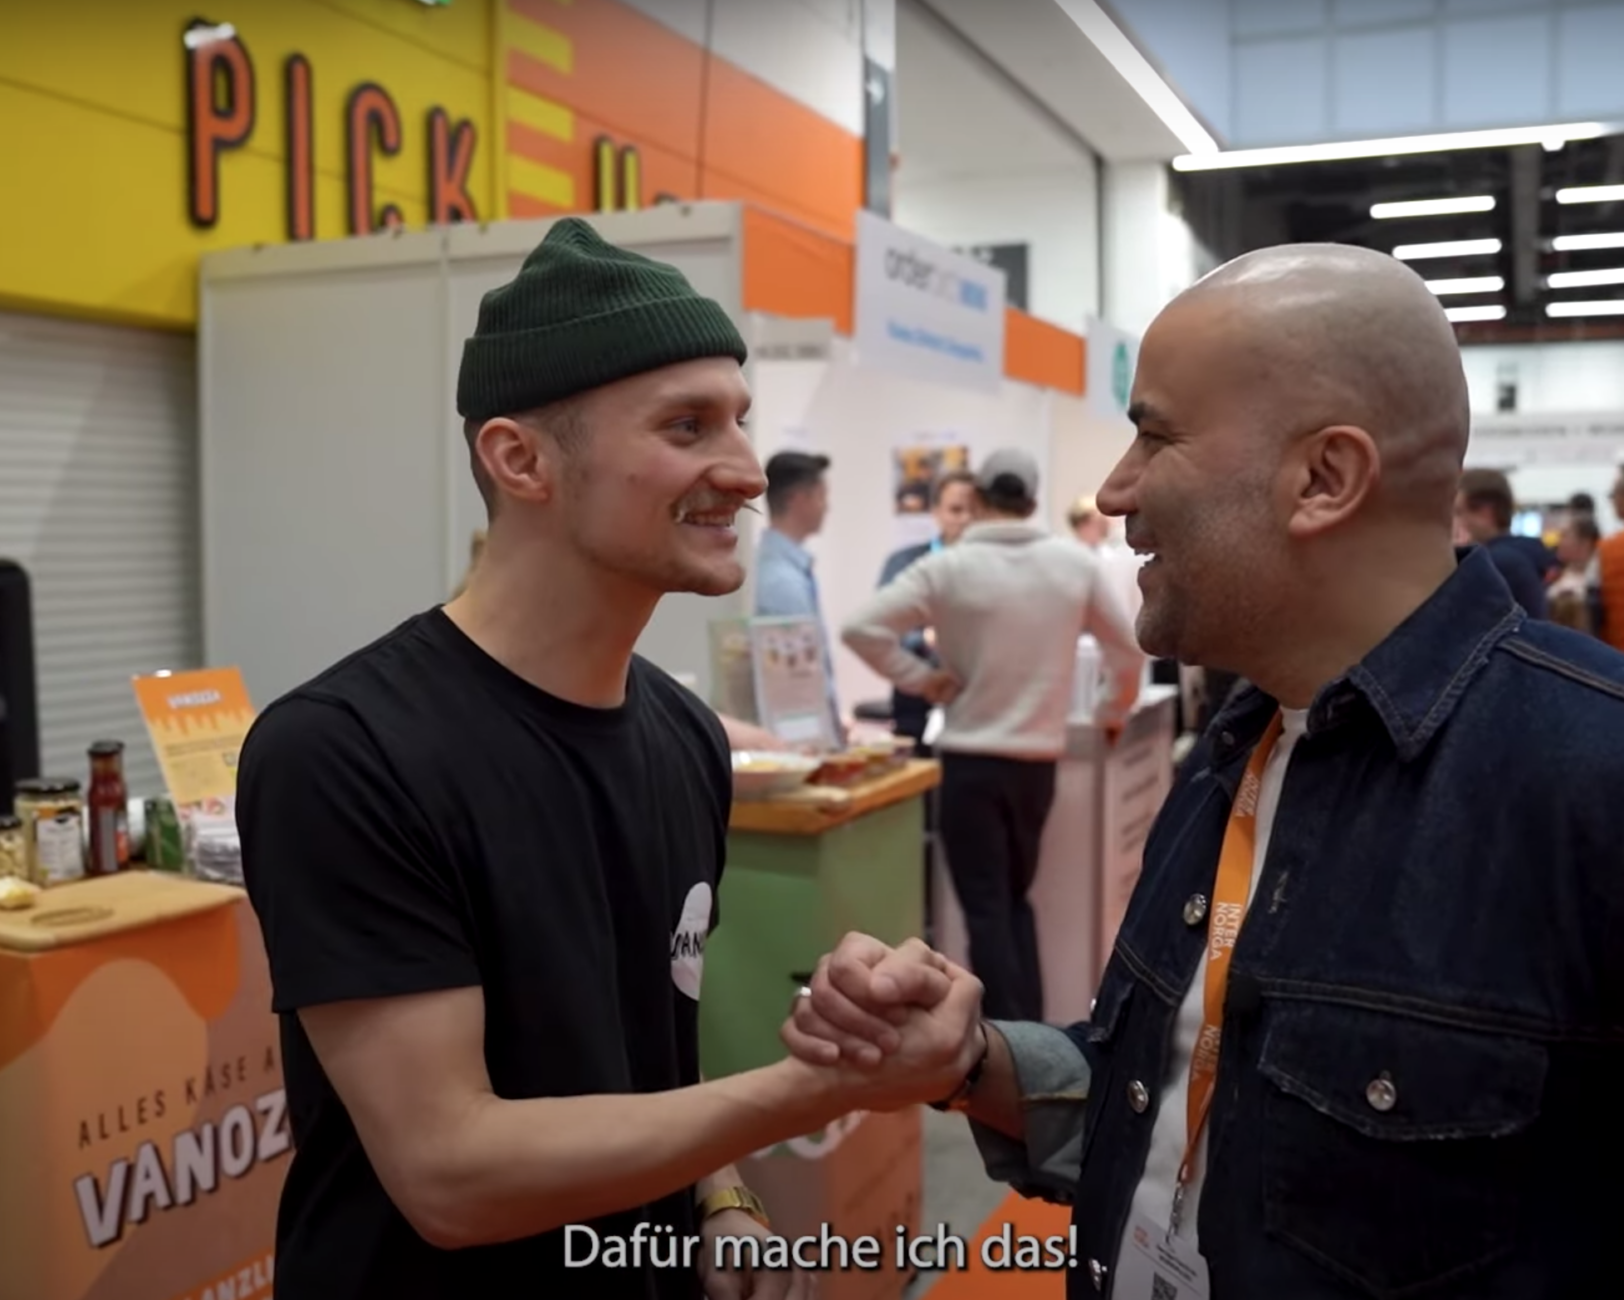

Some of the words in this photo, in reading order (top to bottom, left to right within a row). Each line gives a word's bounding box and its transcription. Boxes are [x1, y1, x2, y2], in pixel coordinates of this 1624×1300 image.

[184, 17, 480, 242] PICK
[1209, 902, 1229, 961] NORGA
[1224, 903, 1243, 948] INTER
[78, 1089, 167, 1149] ALLES
